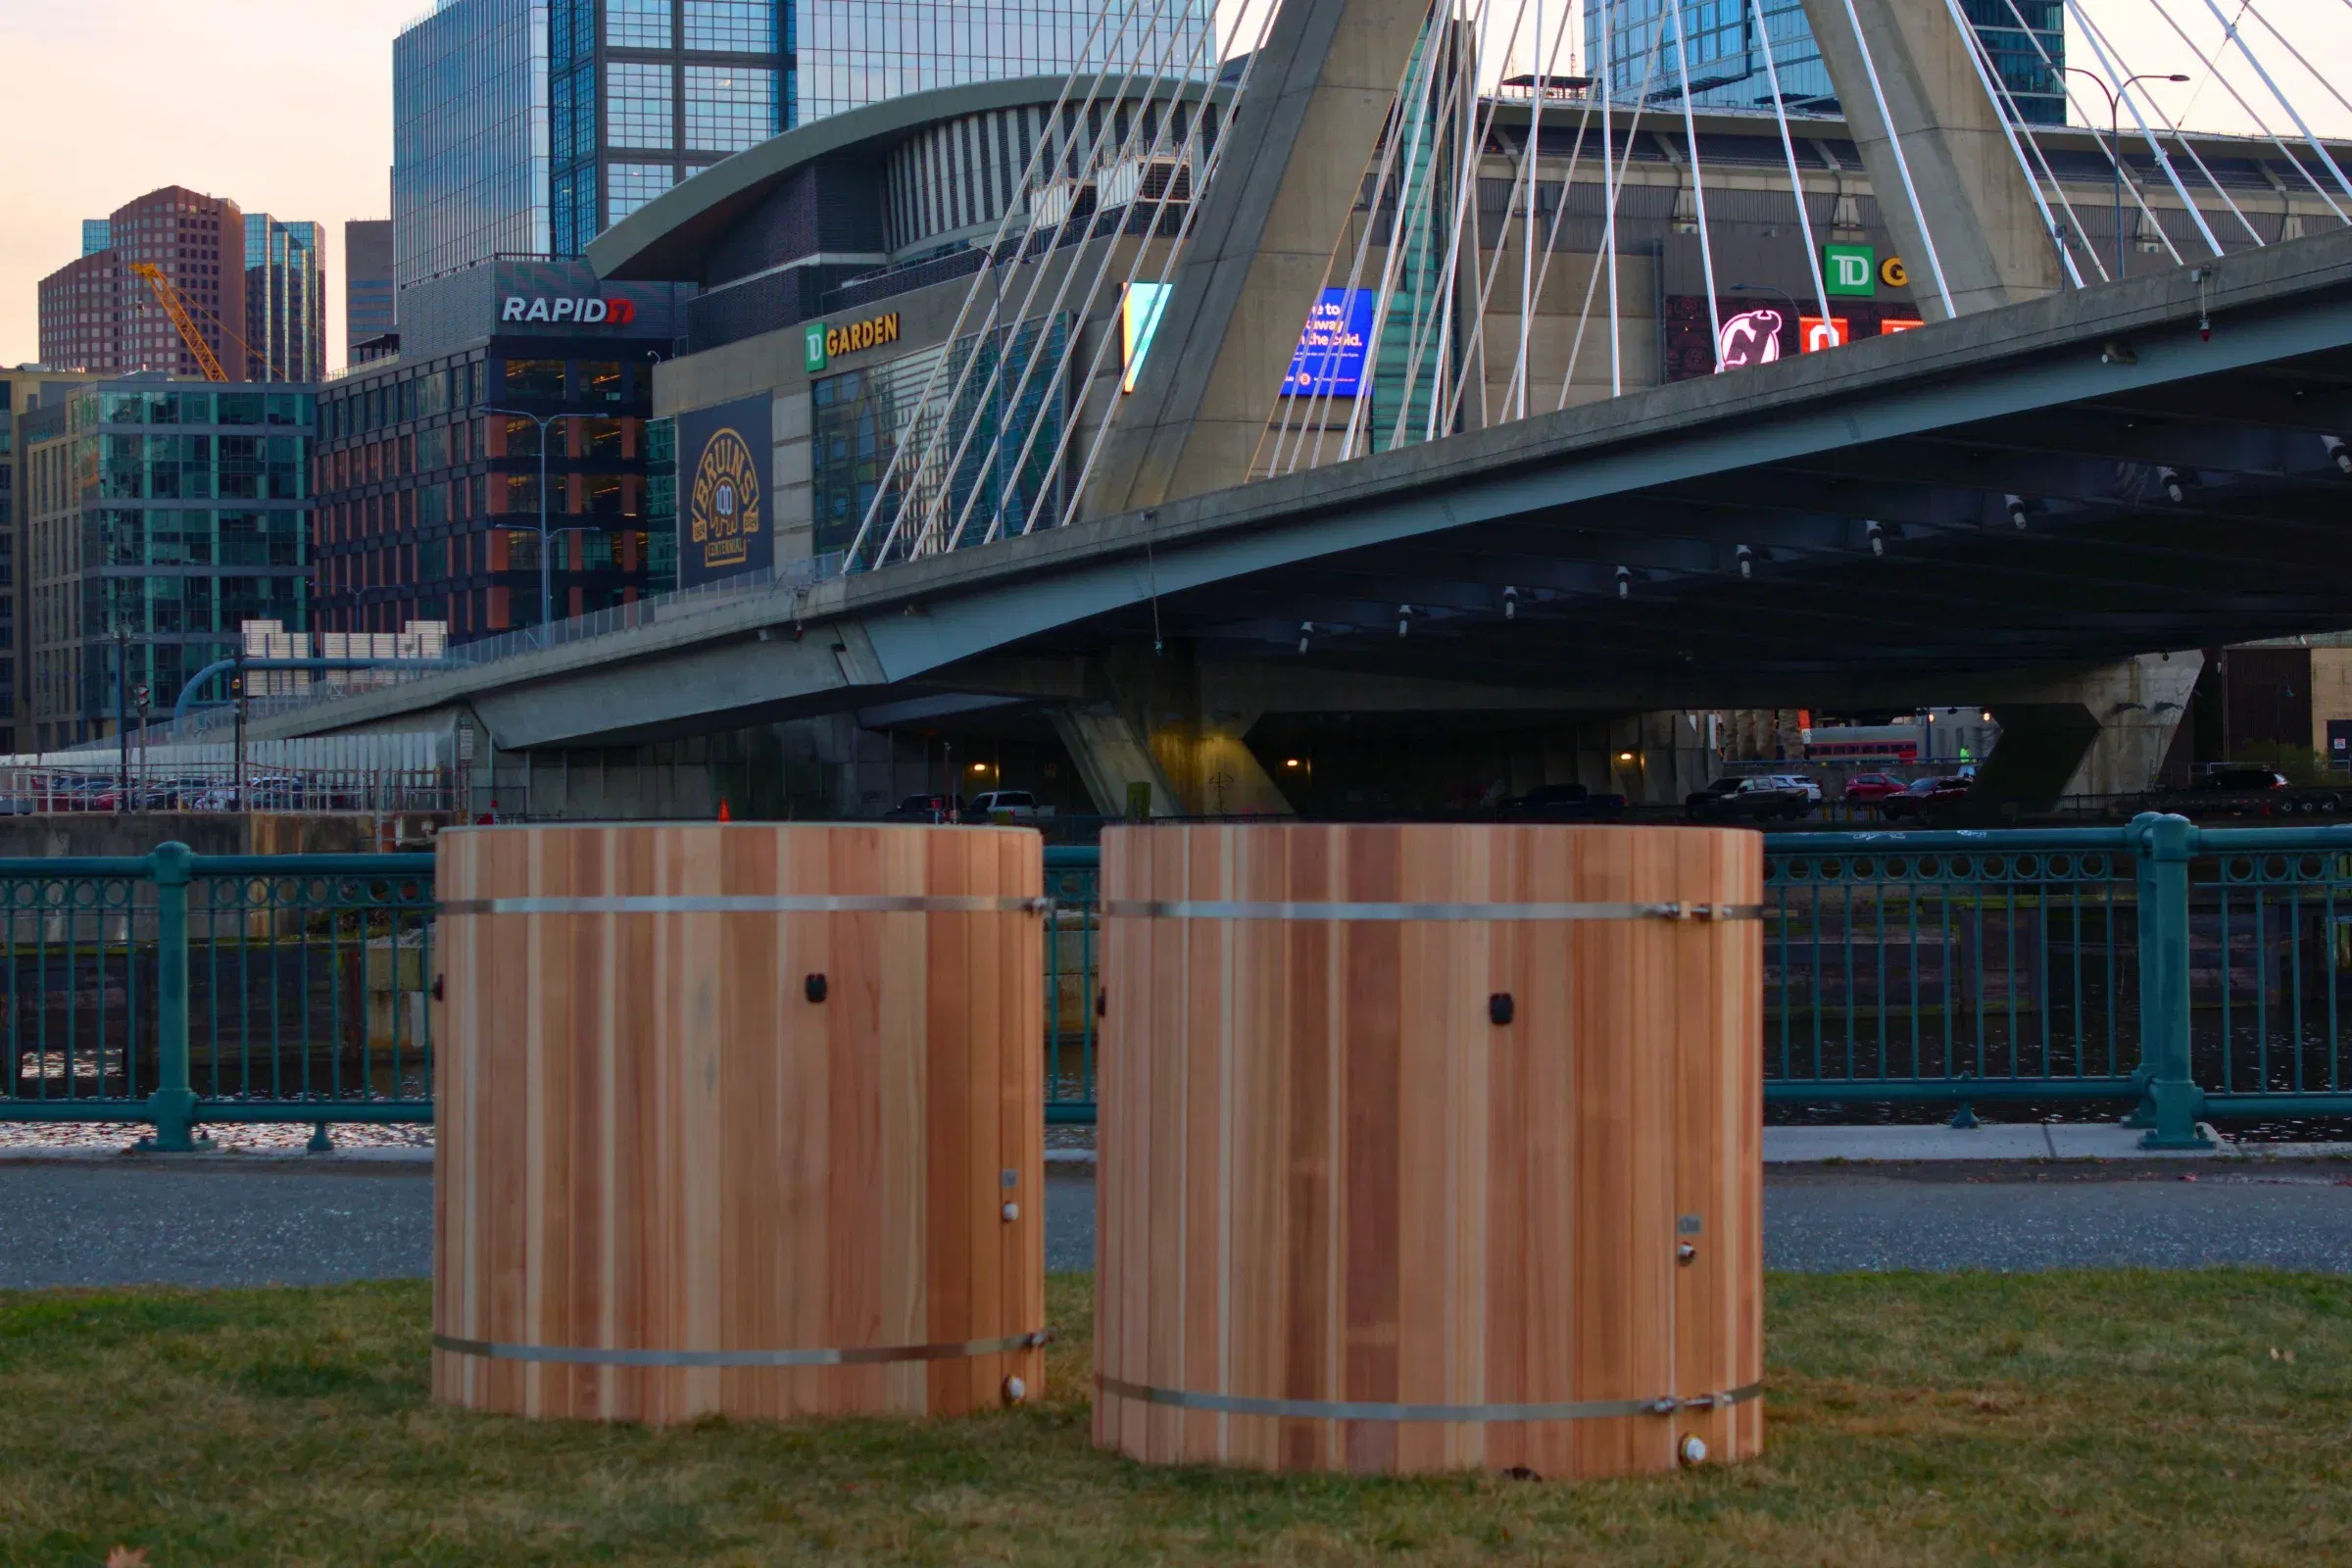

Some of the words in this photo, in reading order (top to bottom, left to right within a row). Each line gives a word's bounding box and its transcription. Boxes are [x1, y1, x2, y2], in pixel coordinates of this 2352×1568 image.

[1831, 255, 1870, 286] TD
[1325, 303, 1341, 316] to
[807, 333, 822, 362] TD
[825, 312, 899, 358] GARDEN
[696, 438, 755, 514] BRUINS
[716, 485, 733, 515] 100
